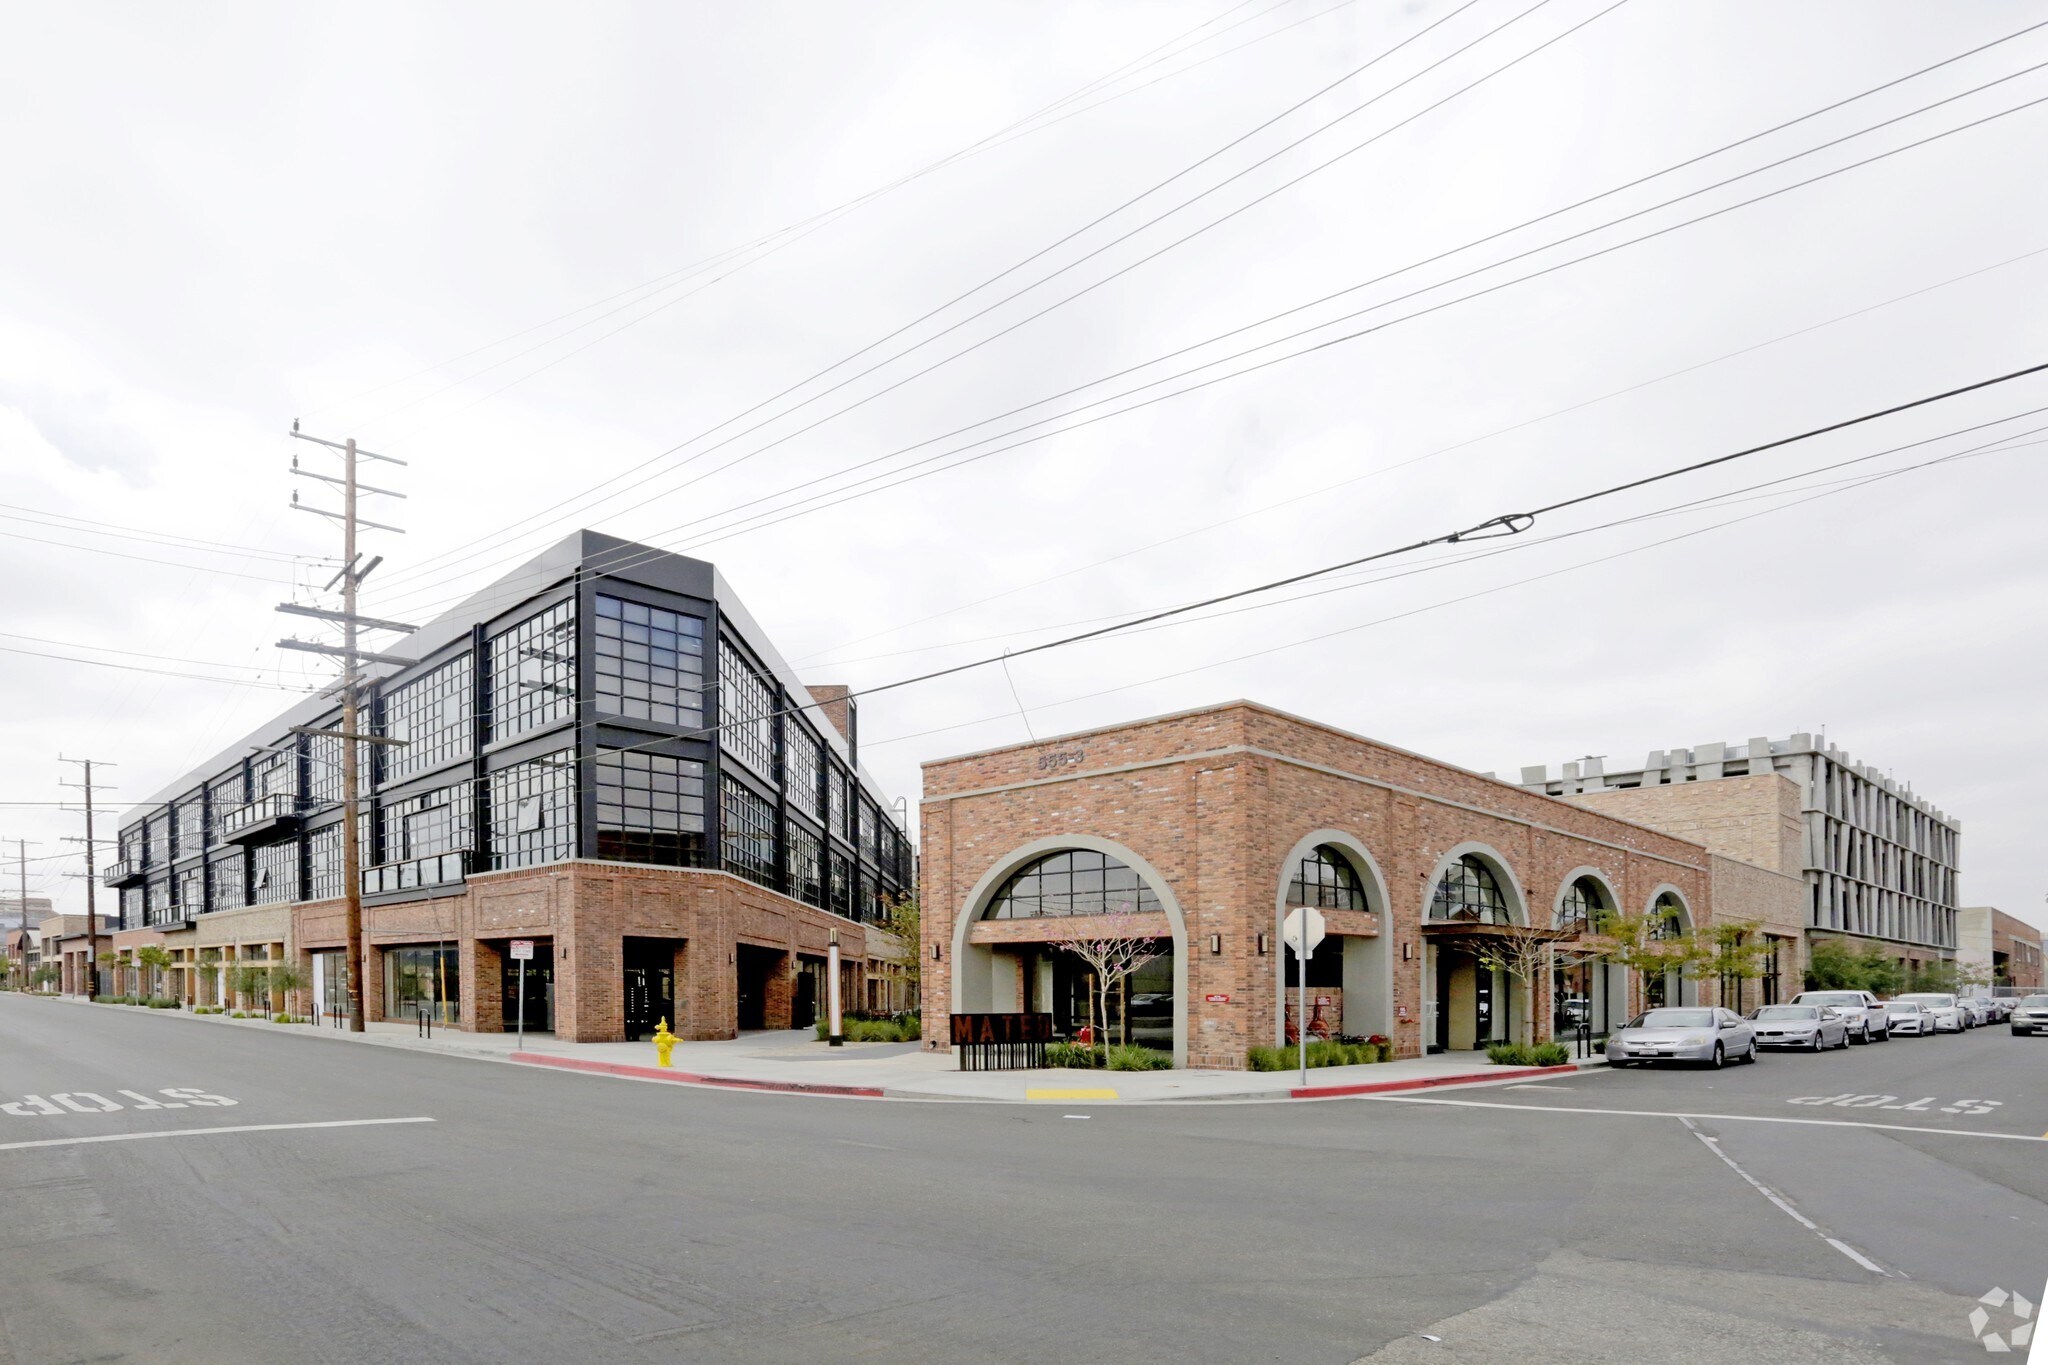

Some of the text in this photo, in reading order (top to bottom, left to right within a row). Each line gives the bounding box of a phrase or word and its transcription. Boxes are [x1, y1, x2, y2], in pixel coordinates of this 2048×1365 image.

[954, 1015, 1050, 1043] MATEO
[0, 1088, 239, 1116] STOP
[1786, 1093, 2004, 1115] STOP
